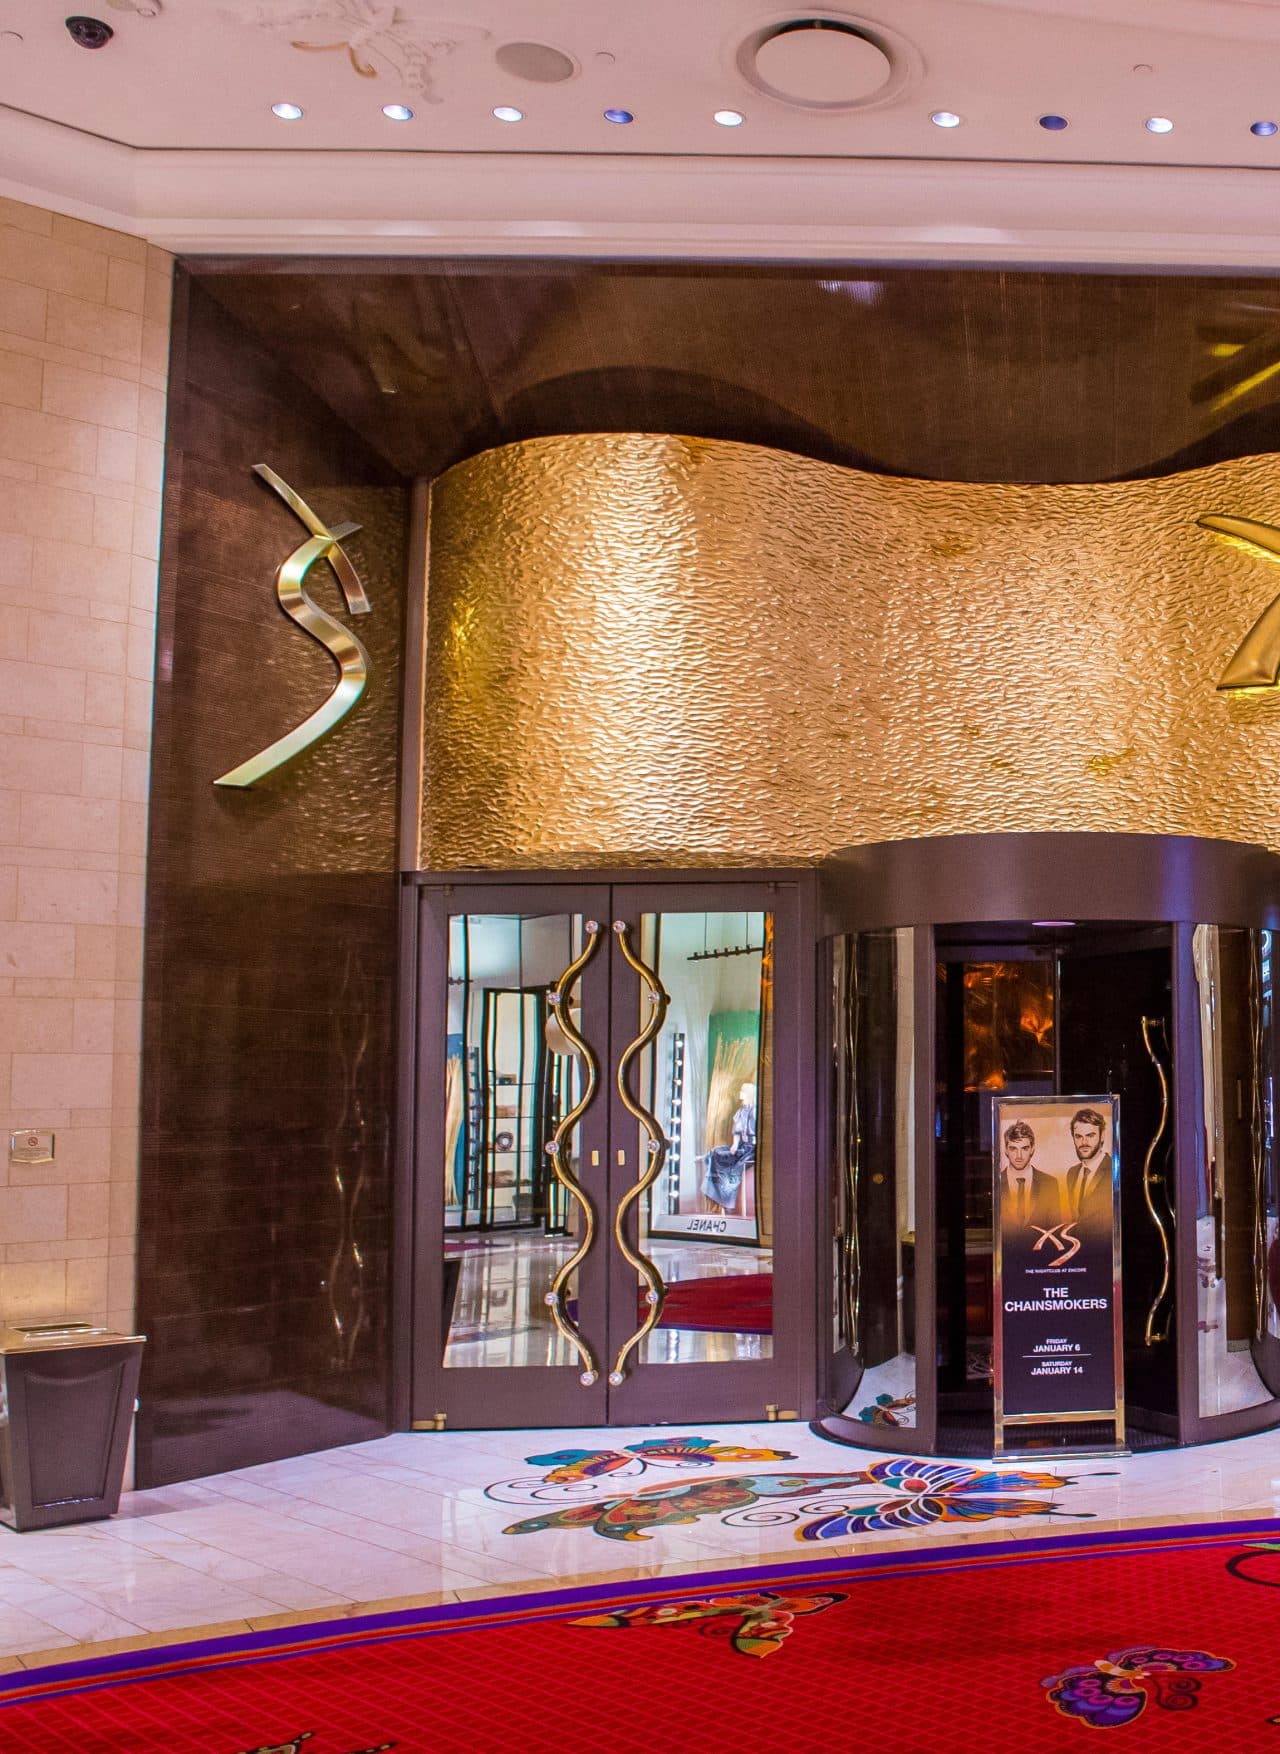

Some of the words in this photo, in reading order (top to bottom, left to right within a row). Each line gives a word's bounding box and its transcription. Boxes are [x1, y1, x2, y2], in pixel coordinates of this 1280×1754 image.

[1030, 1222, 1081, 1267] XS
[1043, 1287, 1069, 1298] THE
[1004, 1298, 1108, 1312] CHAINSMOKERS
[1033, 1344, 1074, 1353] JANUARY
[1074, 1343, 1081, 1352] 6
[1030, 1367, 1072, 1376] JANUARY
[1073, 1366, 1083, 1374] 14
